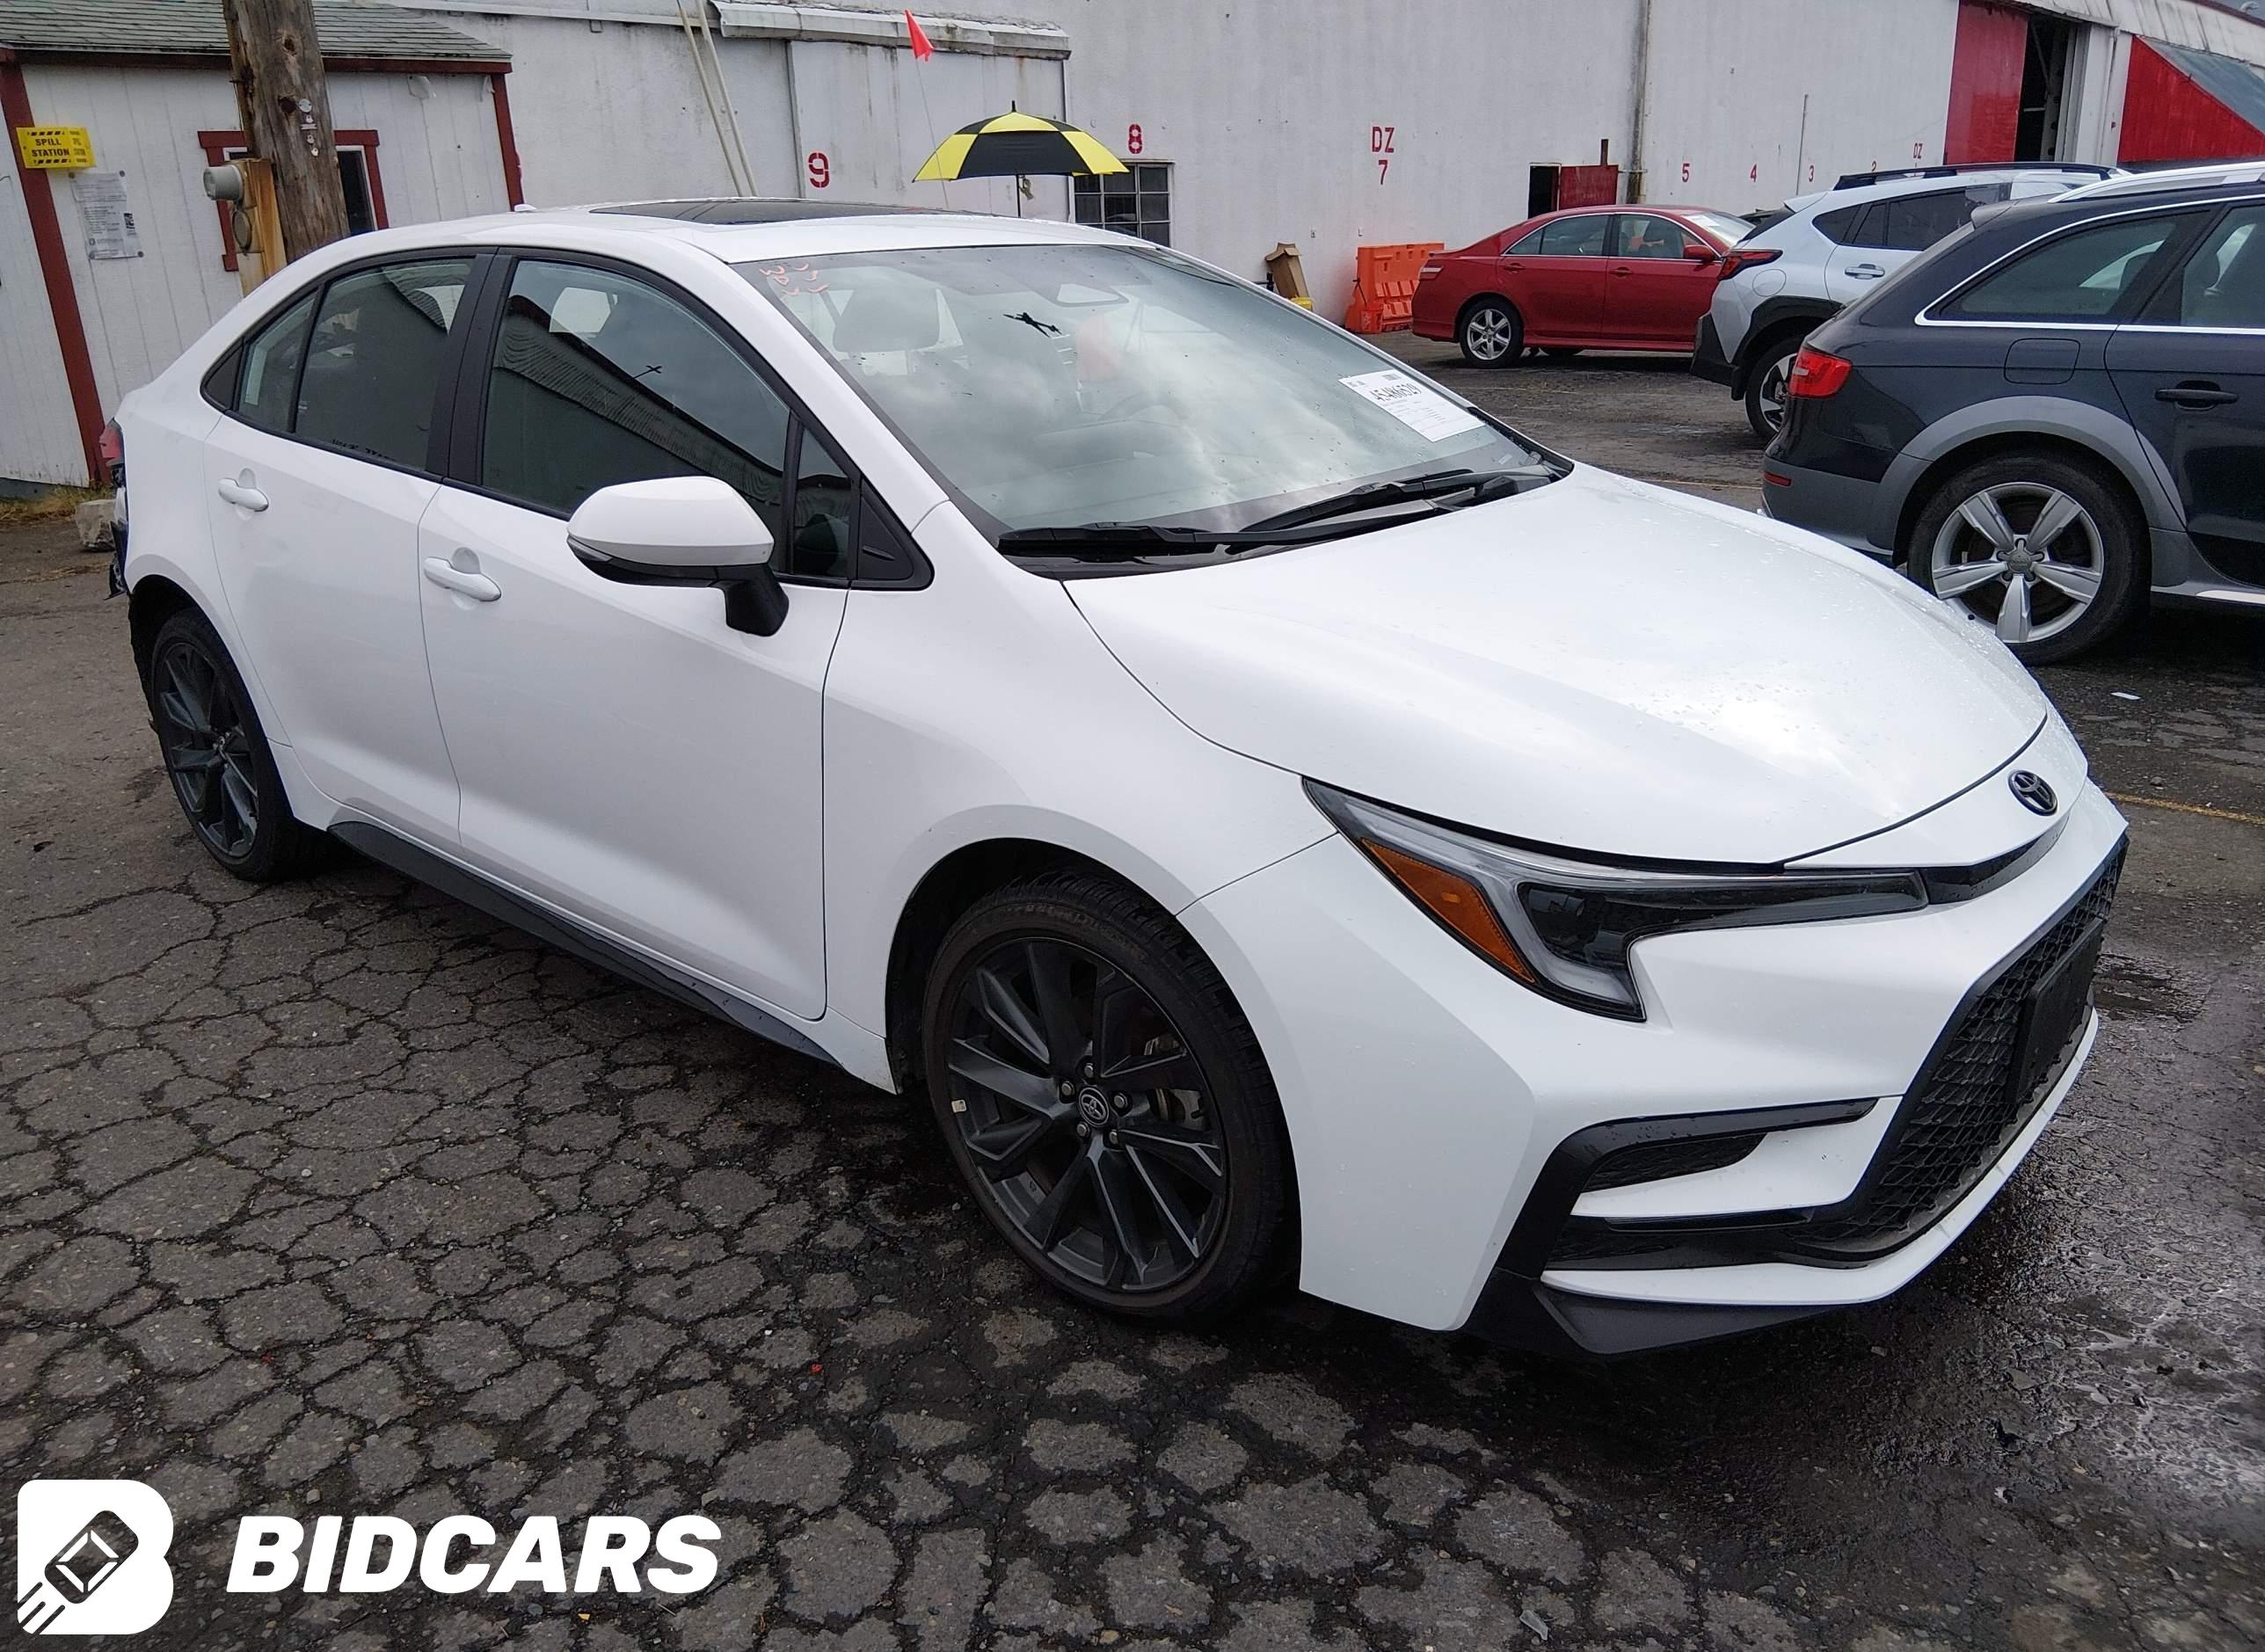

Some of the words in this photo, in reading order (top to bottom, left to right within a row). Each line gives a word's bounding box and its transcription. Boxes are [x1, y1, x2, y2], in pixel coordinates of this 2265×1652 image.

[1127, 123, 1144, 155] 8
[1372, 126, 1395, 154] DZ
[32, 148, 70, 157] STATION
[808, 152, 830, 188] 9
[1378, 159, 1388, 186] 7
[1681, 163, 1691, 183] 5
[1750, 164, 1759, 183] 4
[1808, 164, 1815, 183] 3
